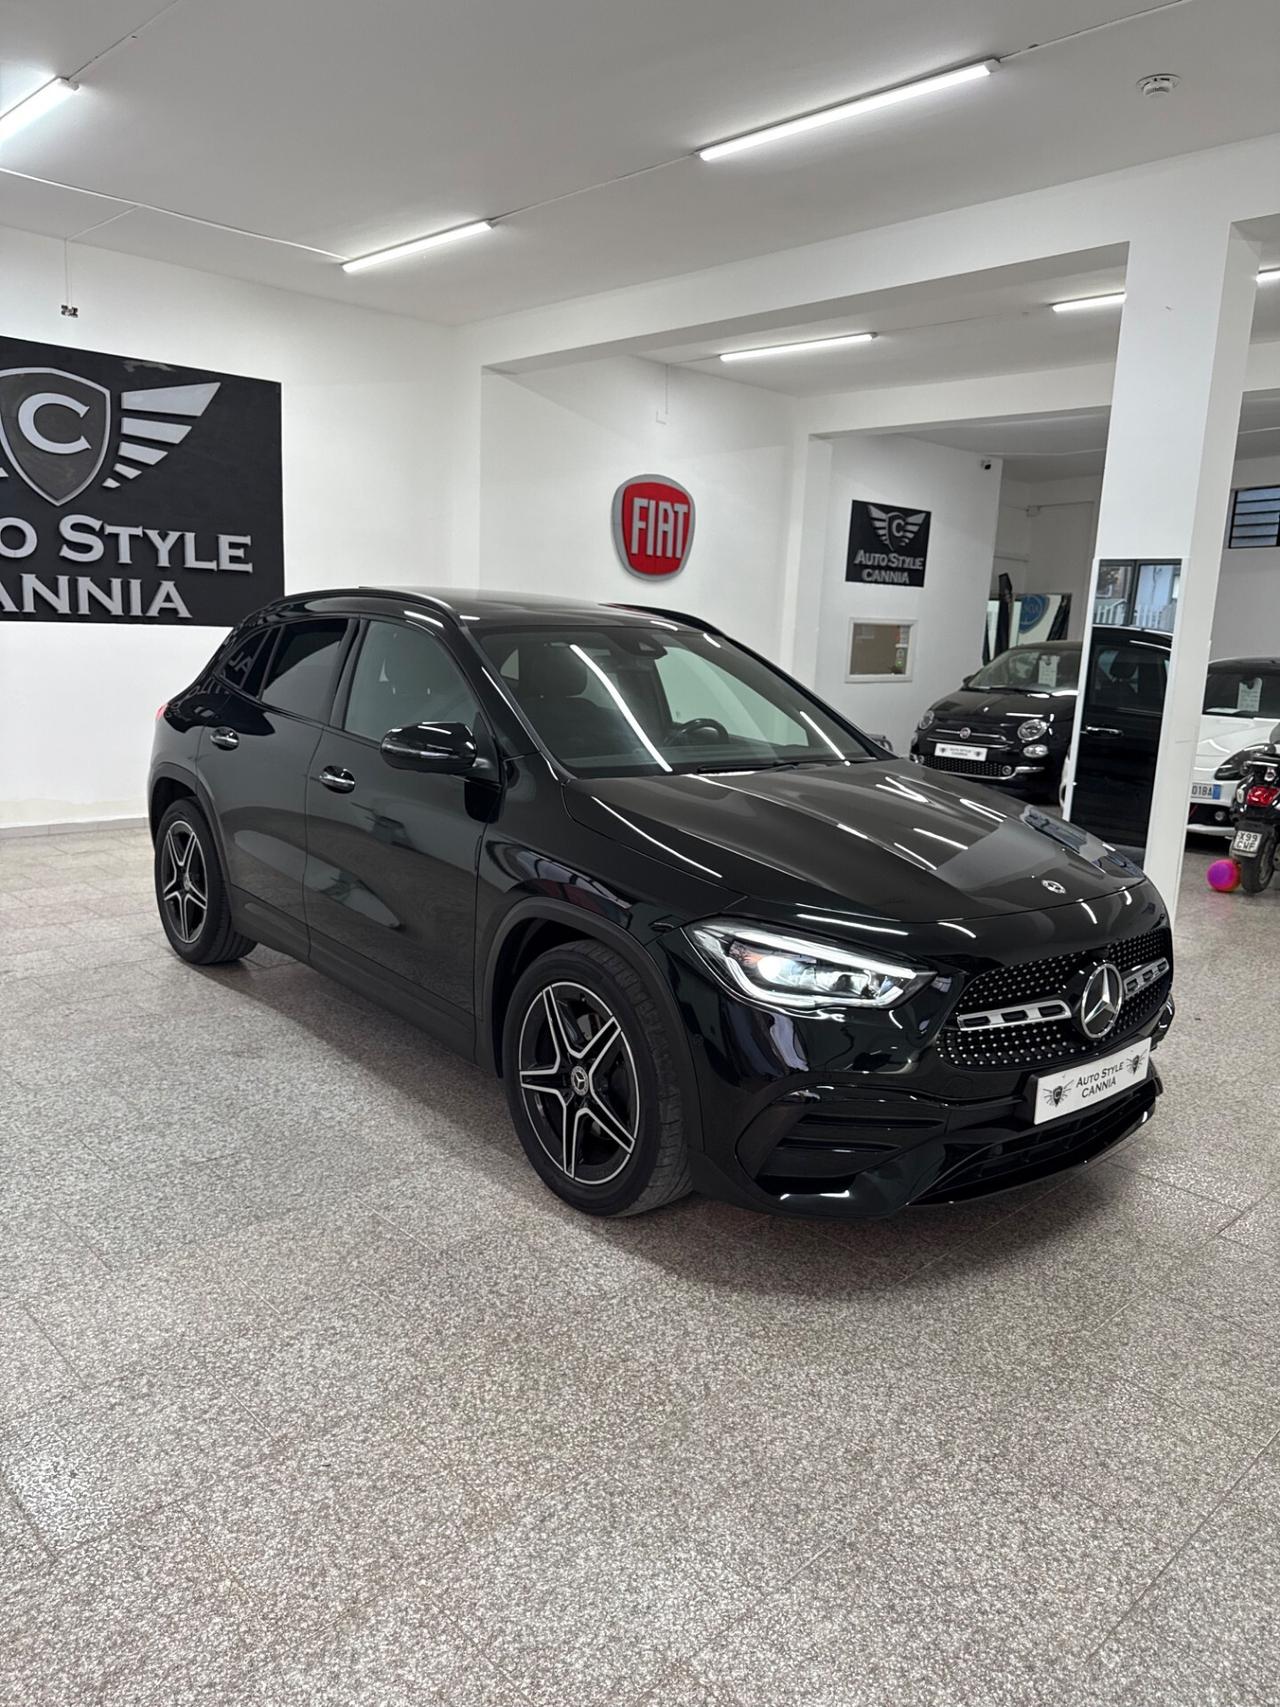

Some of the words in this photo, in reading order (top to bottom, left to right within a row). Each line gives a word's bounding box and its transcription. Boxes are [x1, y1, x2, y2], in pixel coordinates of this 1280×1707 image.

[18, 393, 92, 454] C
[630, 497, 689, 559] FIAT
[58, 513, 253, 574] STYLE
[853, 549, 888, 566] AUTO
[888, 553, 924, 570] STYLE
[862, 568, 910, 584] CANNIA
[1076, 1072, 1100, 1088] AUTO
[1101, 1061, 1124, 1079] STYLE
[1081, 1076, 1117, 1098] CANNIA
